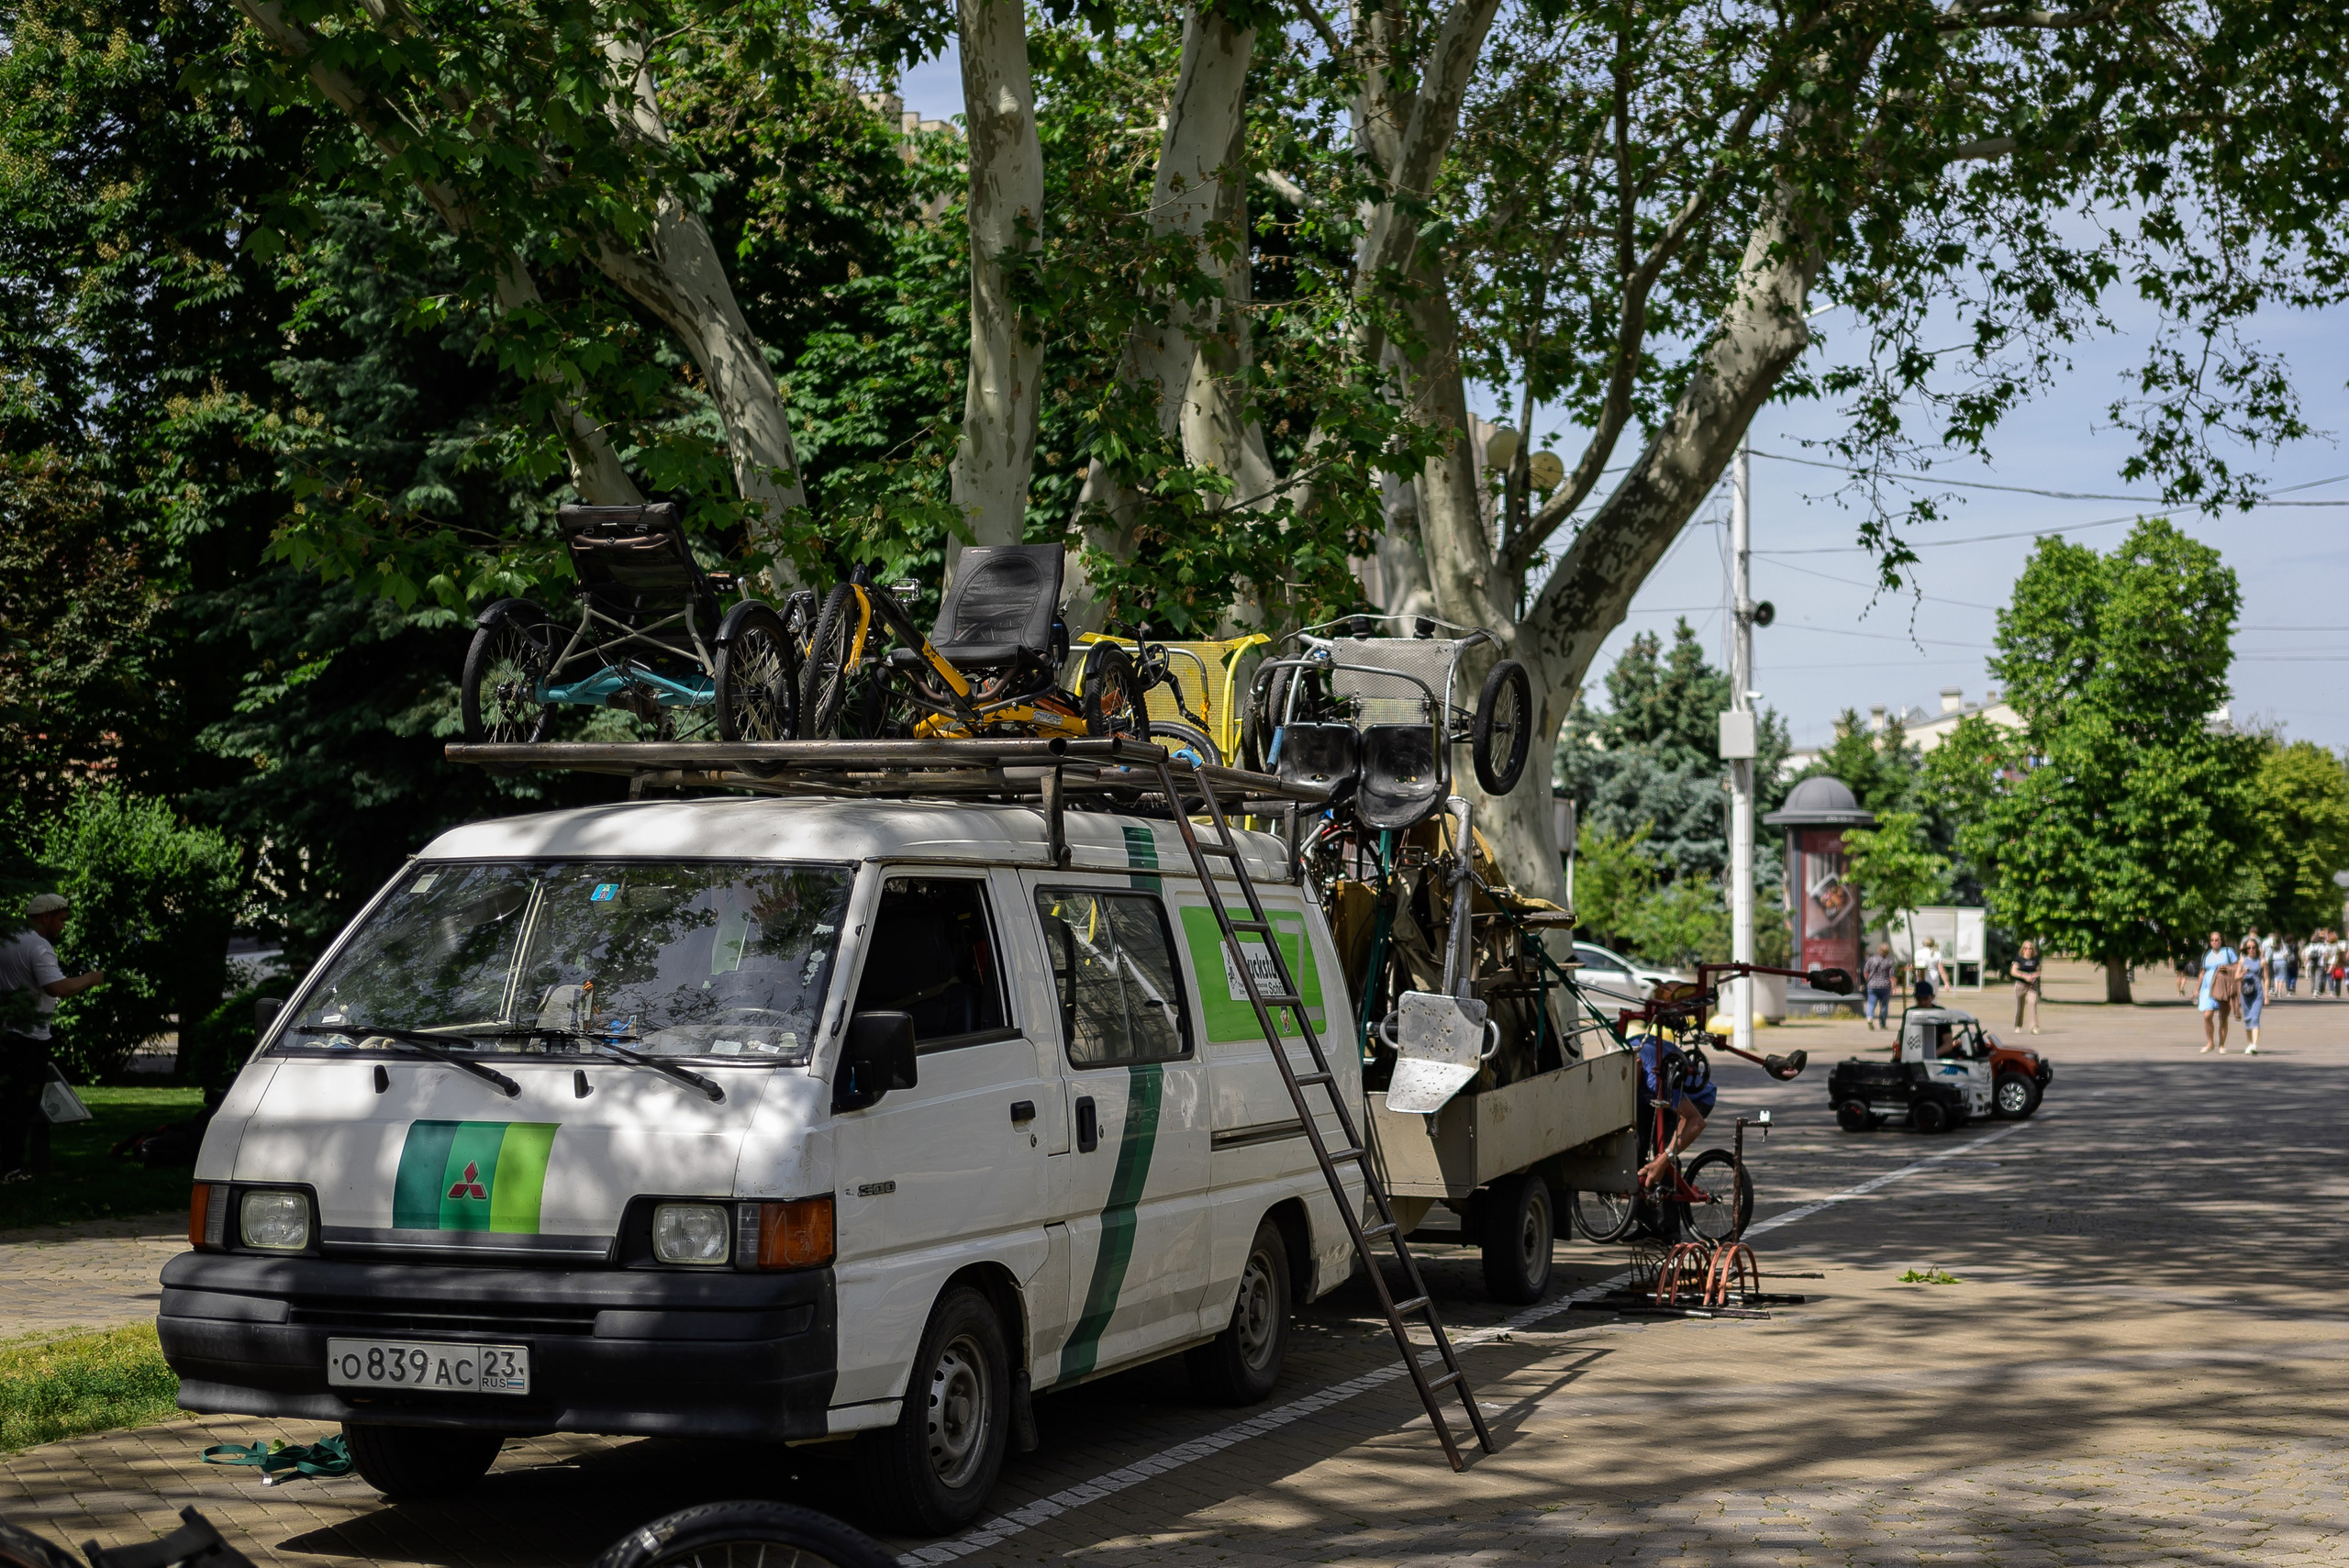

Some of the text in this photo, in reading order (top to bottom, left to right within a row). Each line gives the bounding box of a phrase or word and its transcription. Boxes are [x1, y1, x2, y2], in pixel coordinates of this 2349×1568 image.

[341, 1347, 516, 1385] O839AC 23
[482, 1377, 507, 1388] RUS
